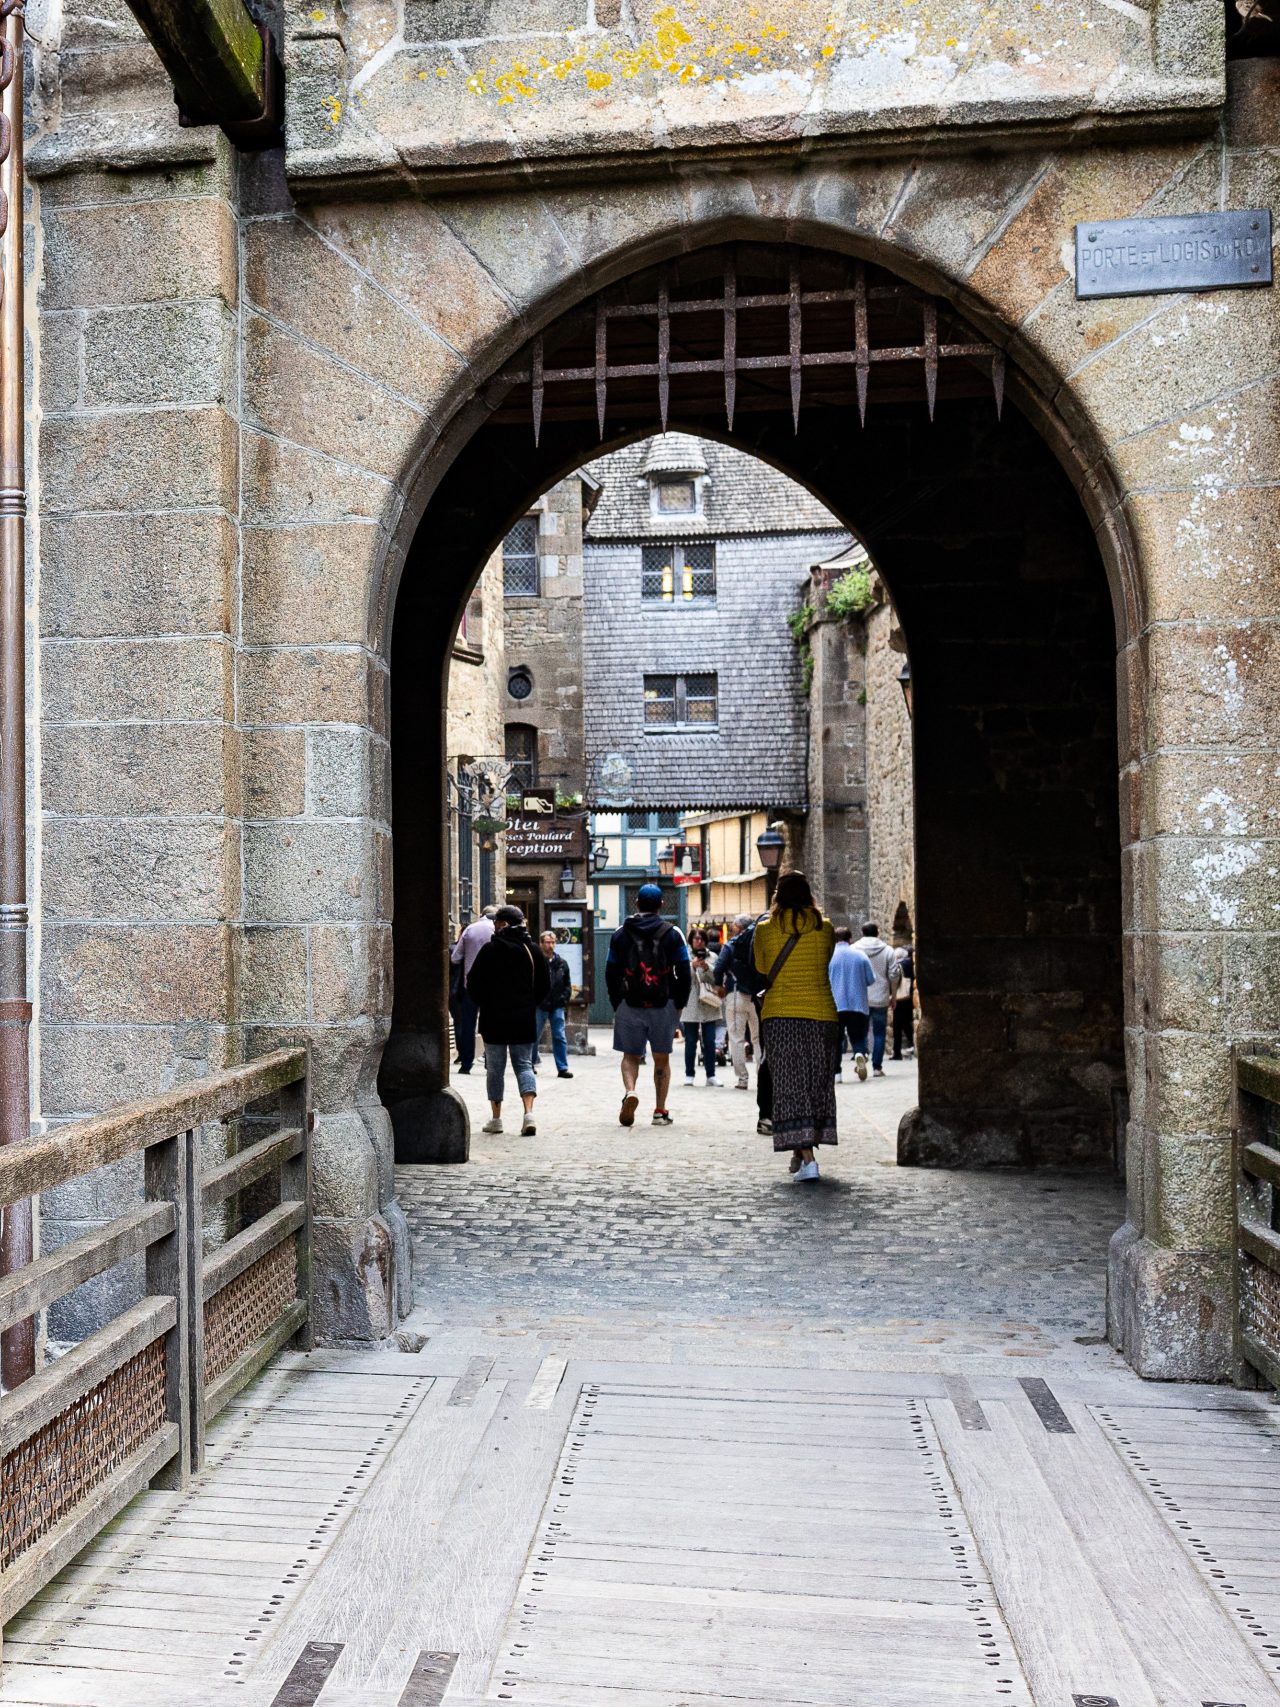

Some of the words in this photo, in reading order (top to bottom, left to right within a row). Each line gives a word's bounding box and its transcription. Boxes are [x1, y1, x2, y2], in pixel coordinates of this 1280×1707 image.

[1081, 244, 1138, 271] PORTE
[1141, 249, 1157, 266] ET
[1159, 239, 1211, 263] LOGIS
[1213, 244, 1230, 259] DU
[505, 816, 540, 831] ôtel
[526, 831, 575, 841] Poulard
